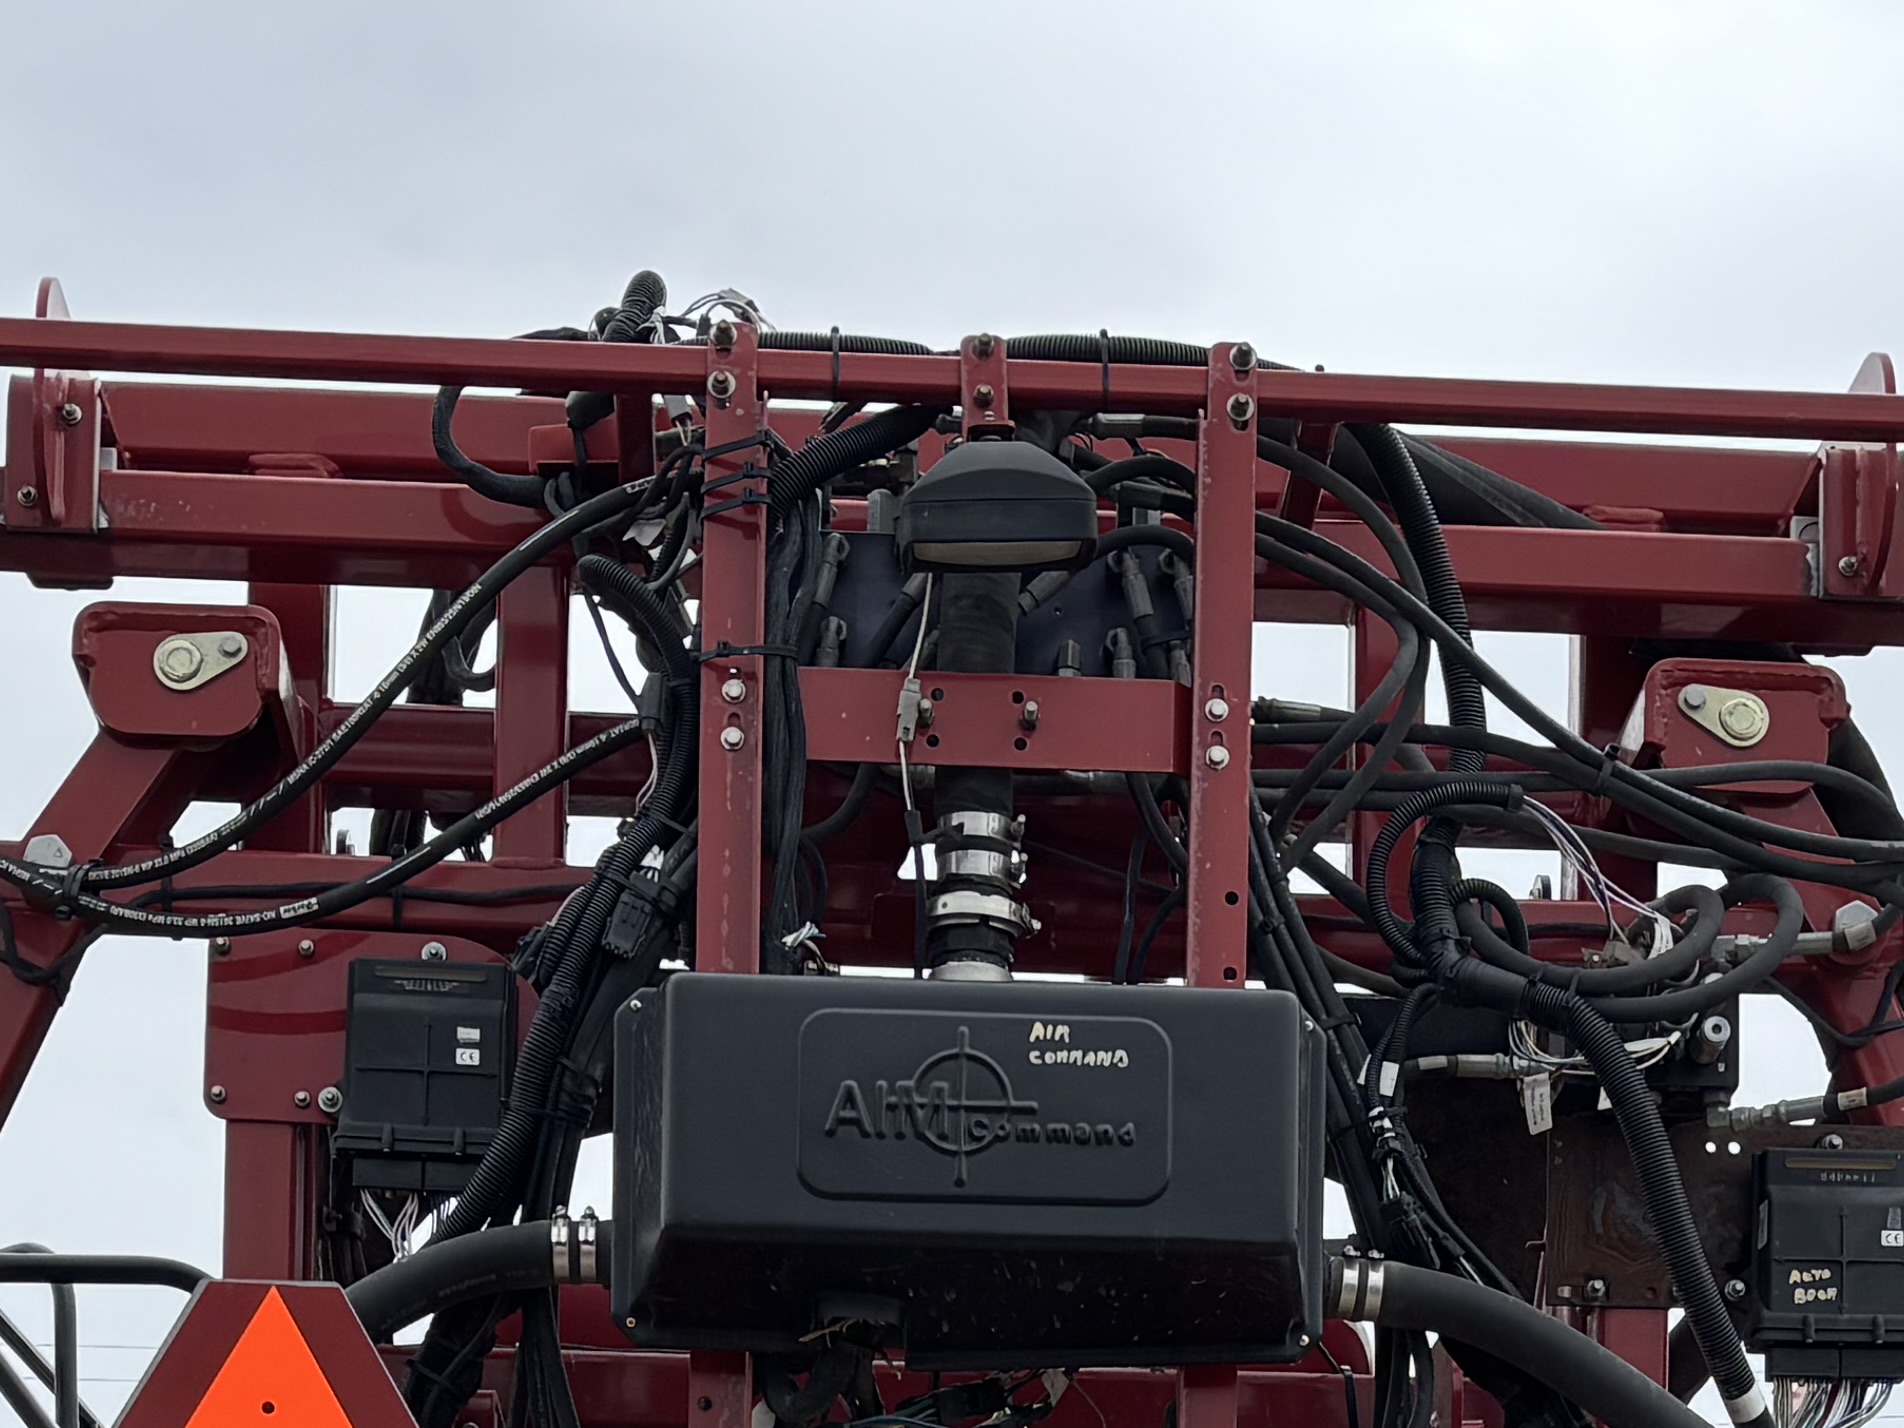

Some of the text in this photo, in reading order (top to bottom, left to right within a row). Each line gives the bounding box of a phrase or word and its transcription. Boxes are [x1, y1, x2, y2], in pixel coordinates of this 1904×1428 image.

[1028, 1048, 1130, 1068] COMMAND
[824, 1078, 950, 1140] AIM
[1793, 1287, 1839, 1305] BOOM
